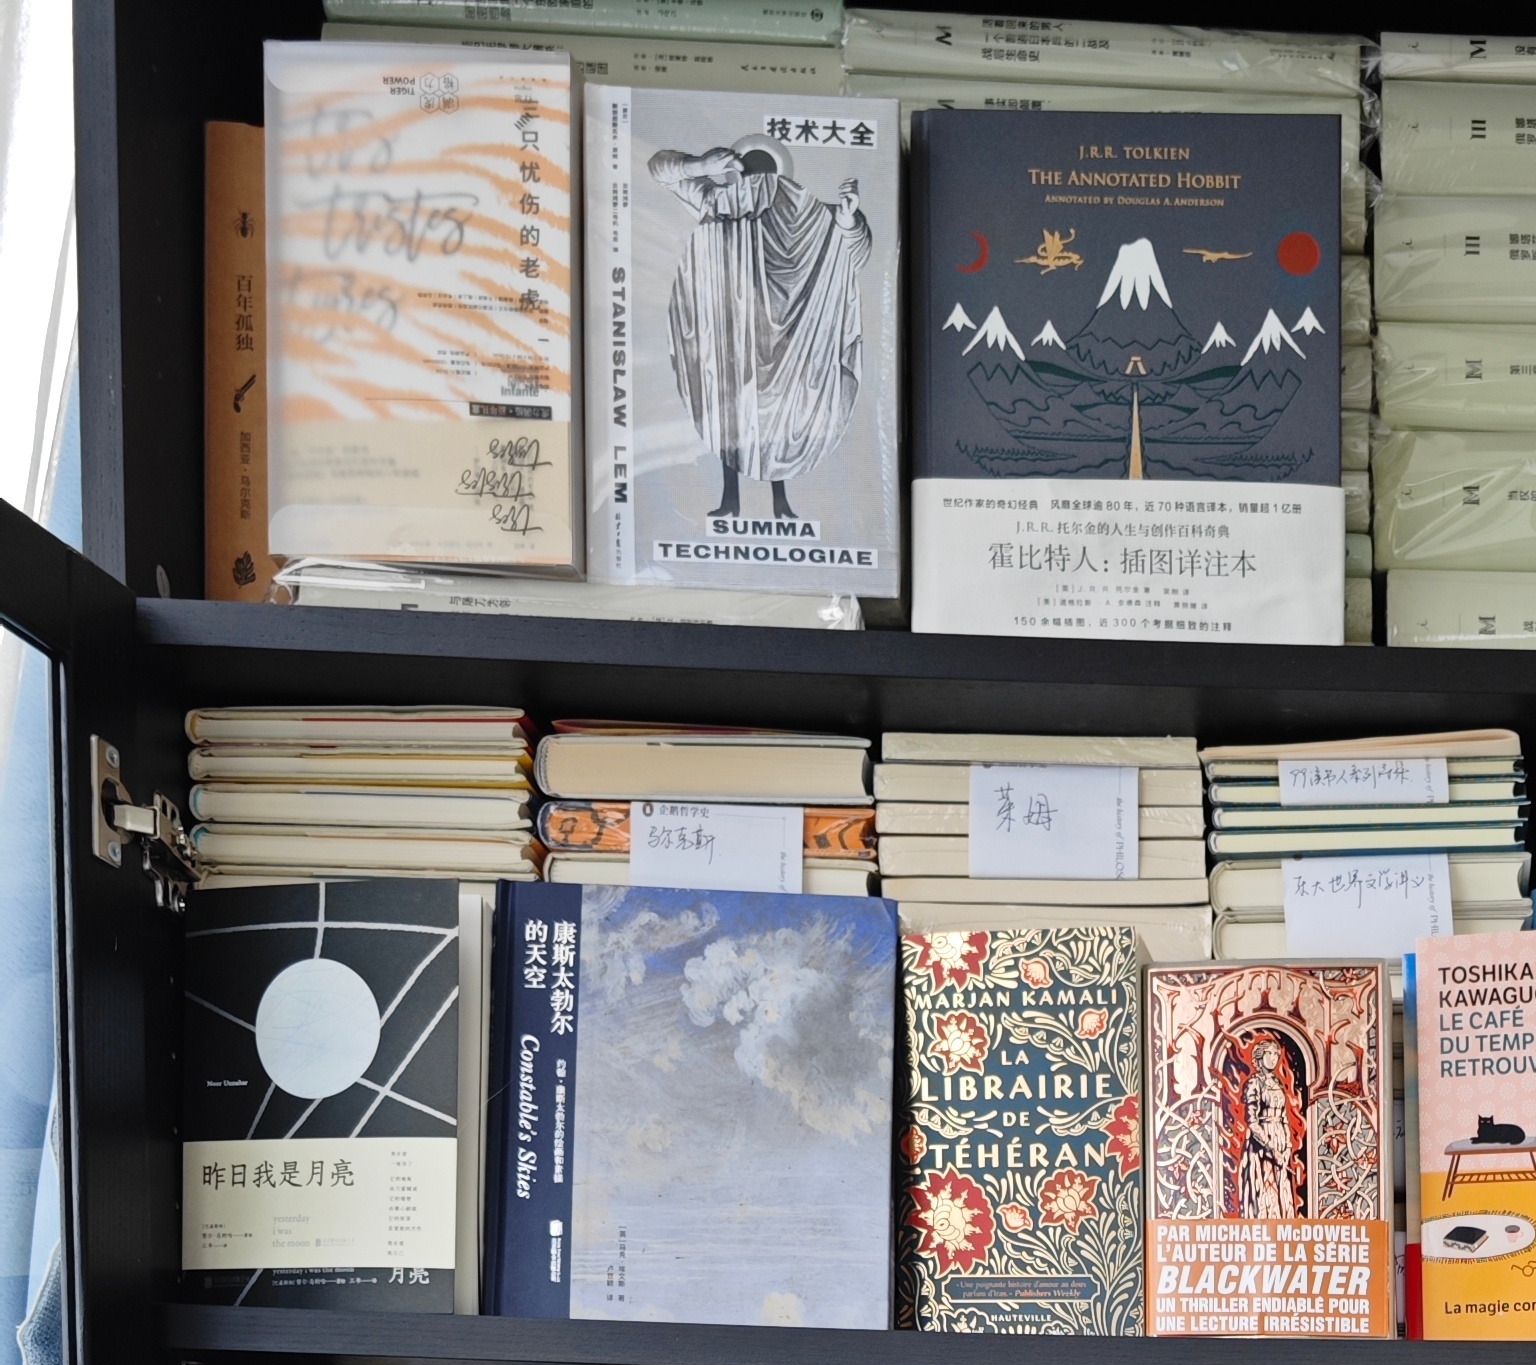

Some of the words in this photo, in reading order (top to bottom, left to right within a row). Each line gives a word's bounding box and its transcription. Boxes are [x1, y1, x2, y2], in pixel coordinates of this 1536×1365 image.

[767, 117, 876, 147] 技术大全
[1079, 146, 1118, 161] J.R.R.
[1123, 147, 1190, 160] TOLKIEN
[1028, 169, 1063, 188] THE
[1067, 170, 1171, 188] ANNOTATED
[1176, 172, 1241, 190] HOBBIT
[234, 274, 256, 352] 百年孤独
[611, 266, 628, 428] STANISŁAW
[612, 446, 628, 504] LEM
[712, 518, 817, 538] SUMMA
[657, 542, 876, 567] TECHNOLOGIAE
[988, 543, 1257, 579] 霍比特人：插图详注本
[994, 781, 1059, 831] 莱姆
[522, 921, 548, 989] 的天空
[551, 921, 577, 1035] 康斯太勃尔
[914, 990, 1011, 1010] MARJAN
[1022, 990, 1119, 1009] KAMALI
[1439, 1011, 1465, 1031] LE
[1468, 1005, 1525, 1030] CAFÉ
[1440, 1034, 1471, 1055] DU
[1001, 1050, 1029, 1066] LA
[518, 1034, 541, 1142] Constable's
[920, 1073, 1113, 1102] LIBRAIRIE
[1003, 1111, 1031, 1127] DE
[929, 1137, 1106, 1171] TÉHÉRAN
[202, 1158, 355, 1191] 昨日我是月亮
[516, 1147, 538, 1199] Skies
[273, 1214, 311, 1224] yesterday
[1158, 1225, 1193, 1242] PAR
[1198, 1225, 1285, 1242] MICHAEL
[1290, 1225, 1371, 1242] McDOWELL
[1157, 1244, 1249, 1263] L'AUTEUR
[1254, 1245, 1280, 1263] DE
[1286, 1245, 1309, 1263] LA
[1313, 1240, 1371, 1263] SÉRIE
[1157, 1266, 1372, 1295] BLACKWATER
[1157, 1298, 1178, 1314] UN
[1181, 1298, 1249, 1314] THRILLER
[1253, 1296, 1325, 1314] ENDIABLÉ
[1328, 1298, 1371, 1314] POUR
[1444, 1299, 1462, 1316] La
[1466, 1300, 1511, 1319] magie
[990, 1313, 1053, 1323] HAUTEVILLE
[1157, 1316, 1186, 1332] UNE
[1190, 1316, 1259, 1332] LECTURE
[1263, 1314, 1371, 1332] IRRÉSISTIBLE
